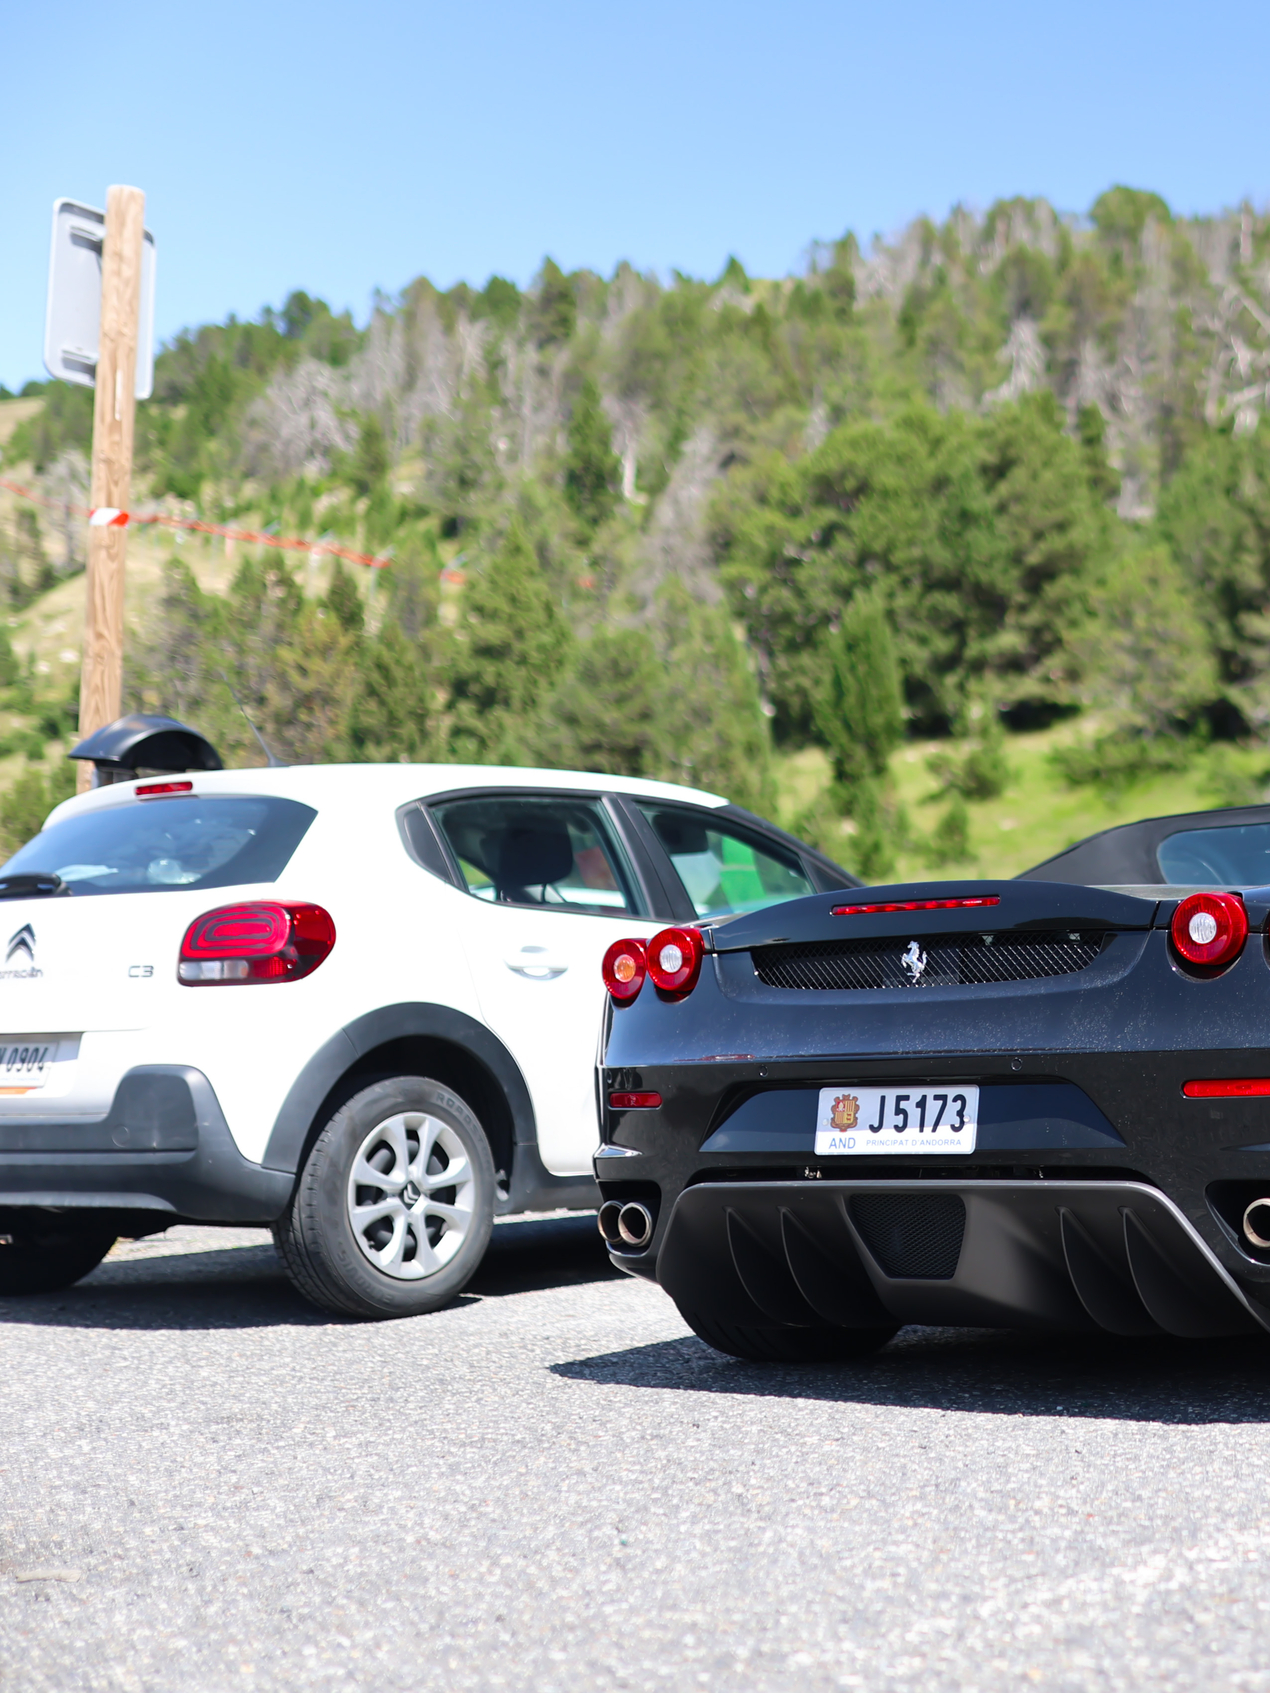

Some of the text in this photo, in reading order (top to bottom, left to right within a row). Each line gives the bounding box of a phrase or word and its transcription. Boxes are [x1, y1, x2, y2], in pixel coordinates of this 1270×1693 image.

[128, 965, 154, 978] C3
[868, 1094, 967, 1133] J5173
[829, 1138, 856, 1149] AND
[866, 1139, 962, 1147] PRINCIPAT D'ANDORRA
